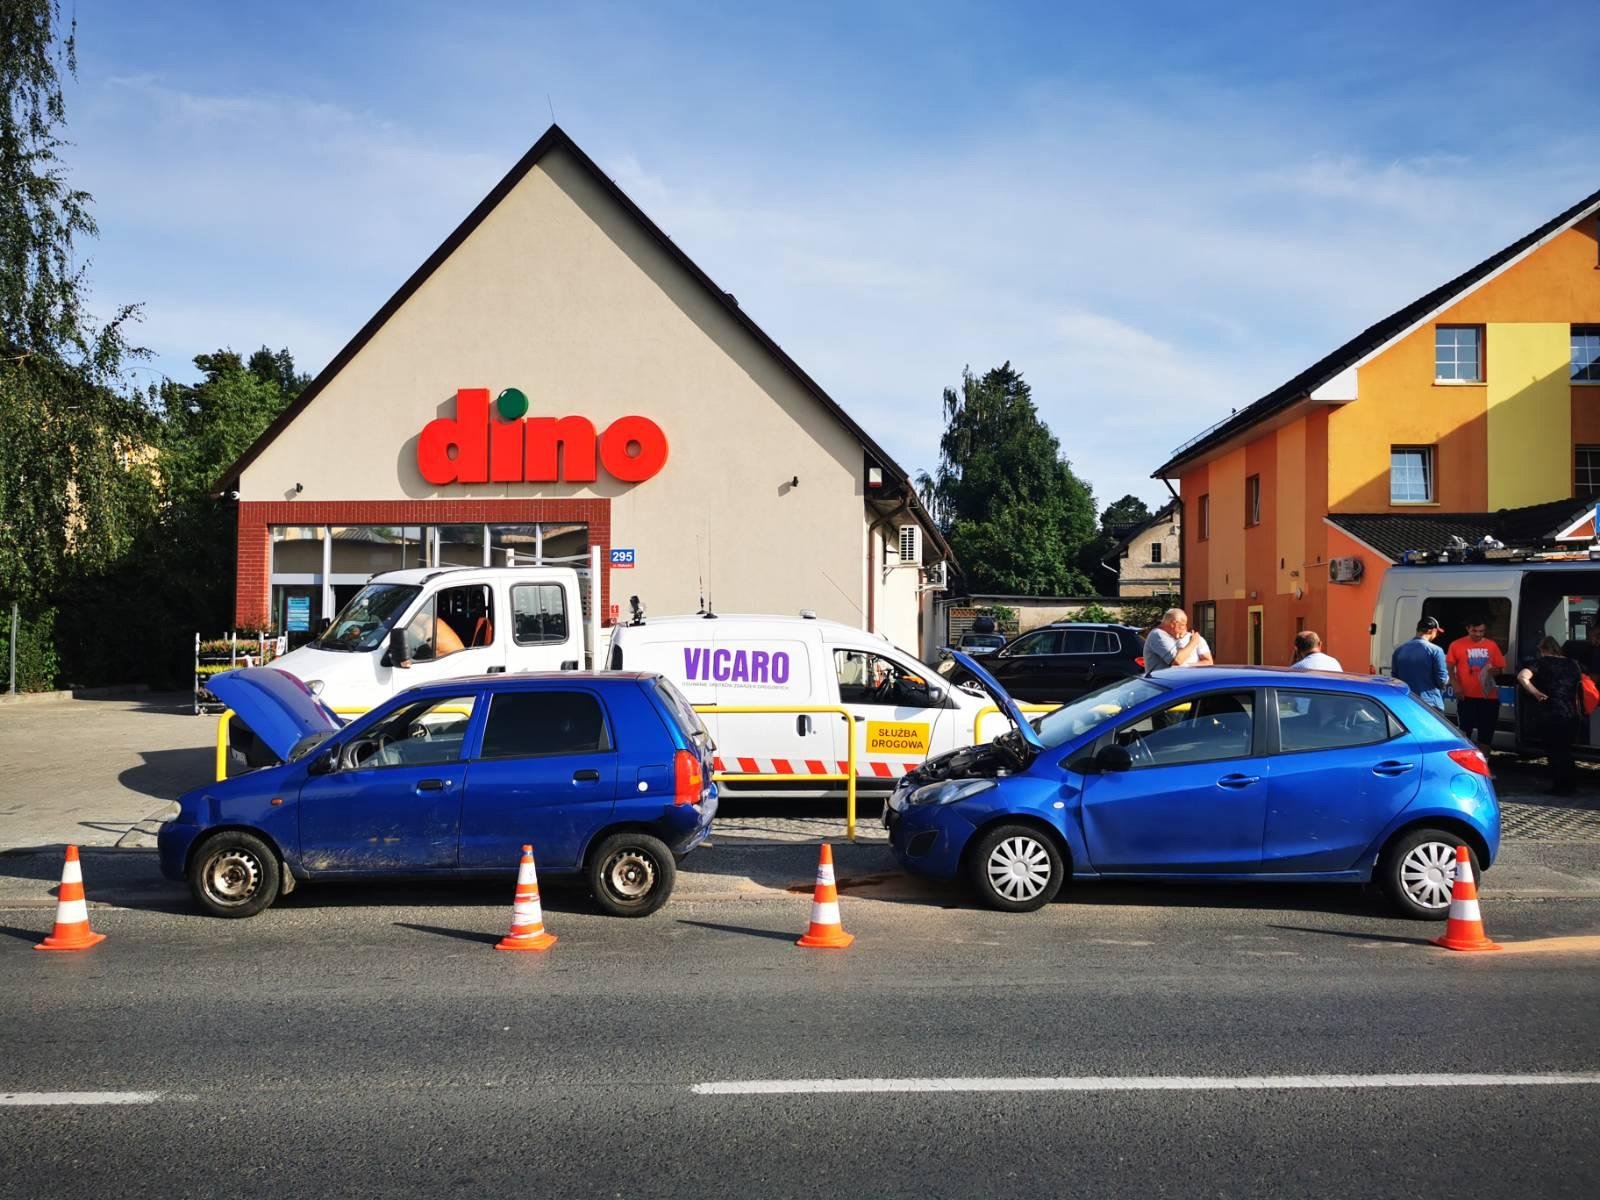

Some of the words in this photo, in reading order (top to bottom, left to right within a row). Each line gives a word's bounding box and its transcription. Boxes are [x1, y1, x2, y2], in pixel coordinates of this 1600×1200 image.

[417, 387, 669, 485] dino
[612, 551, 633, 562] 295
[683, 647, 790, 684] VICARO
[878, 727, 918, 738] SŁUŻBA
[871, 738, 924, 750] DROGOWA
